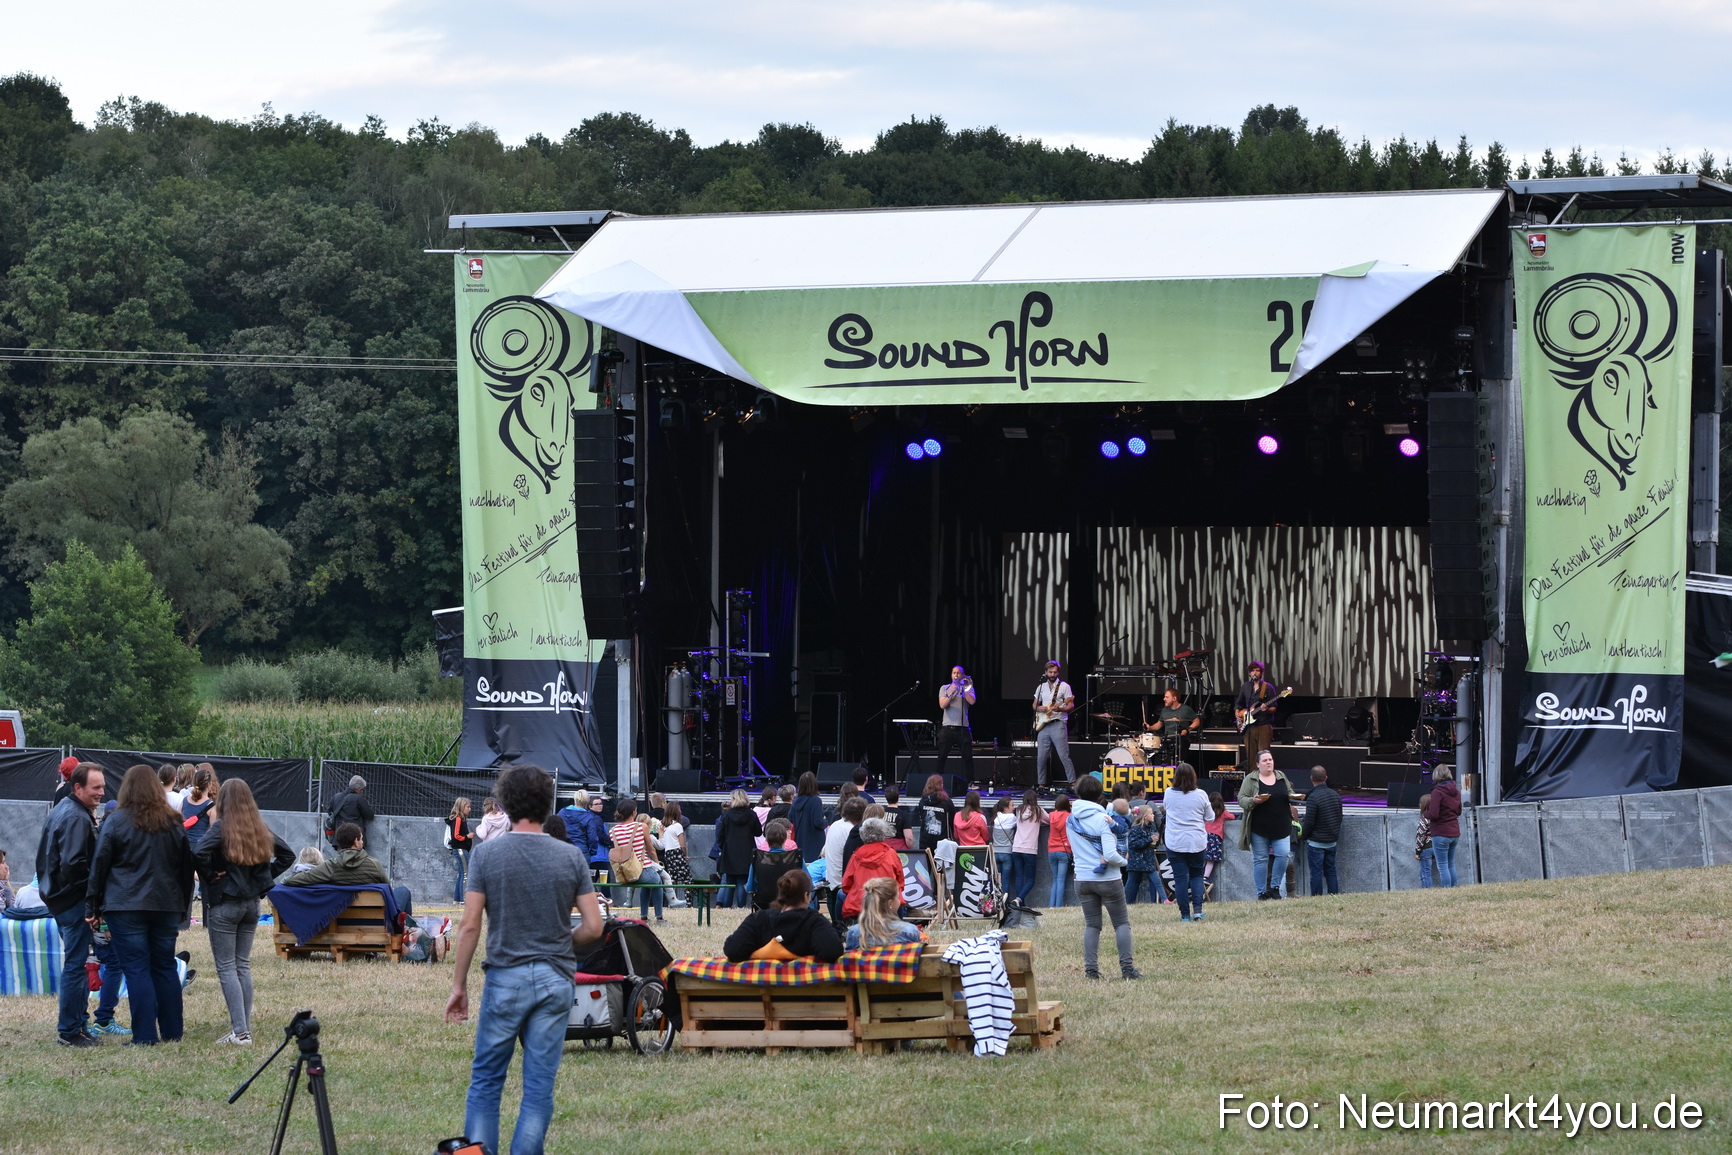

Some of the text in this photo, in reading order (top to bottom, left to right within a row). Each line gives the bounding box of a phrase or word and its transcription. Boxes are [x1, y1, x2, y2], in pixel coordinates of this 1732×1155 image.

[1672, 233, 1684, 264] now
[824, 291, 1109, 391] SOUND HORN
[480, 544, 519, 574] Festival
[518, 533, 534, 553] für
[549, 508, 571, 534] ganze
[1528, 577, 1553, 600] Das
[1550, 546, 1590, 579] Festival
[1589, 535, 1606, 555] für
[1624, 505, 1649, 534] ganze
[1540, 632, 1591, 666] persönlich
[475, 671, 587, 714] SOUND HORN
[1535, 684, 1667, 733] SOUND HORN
